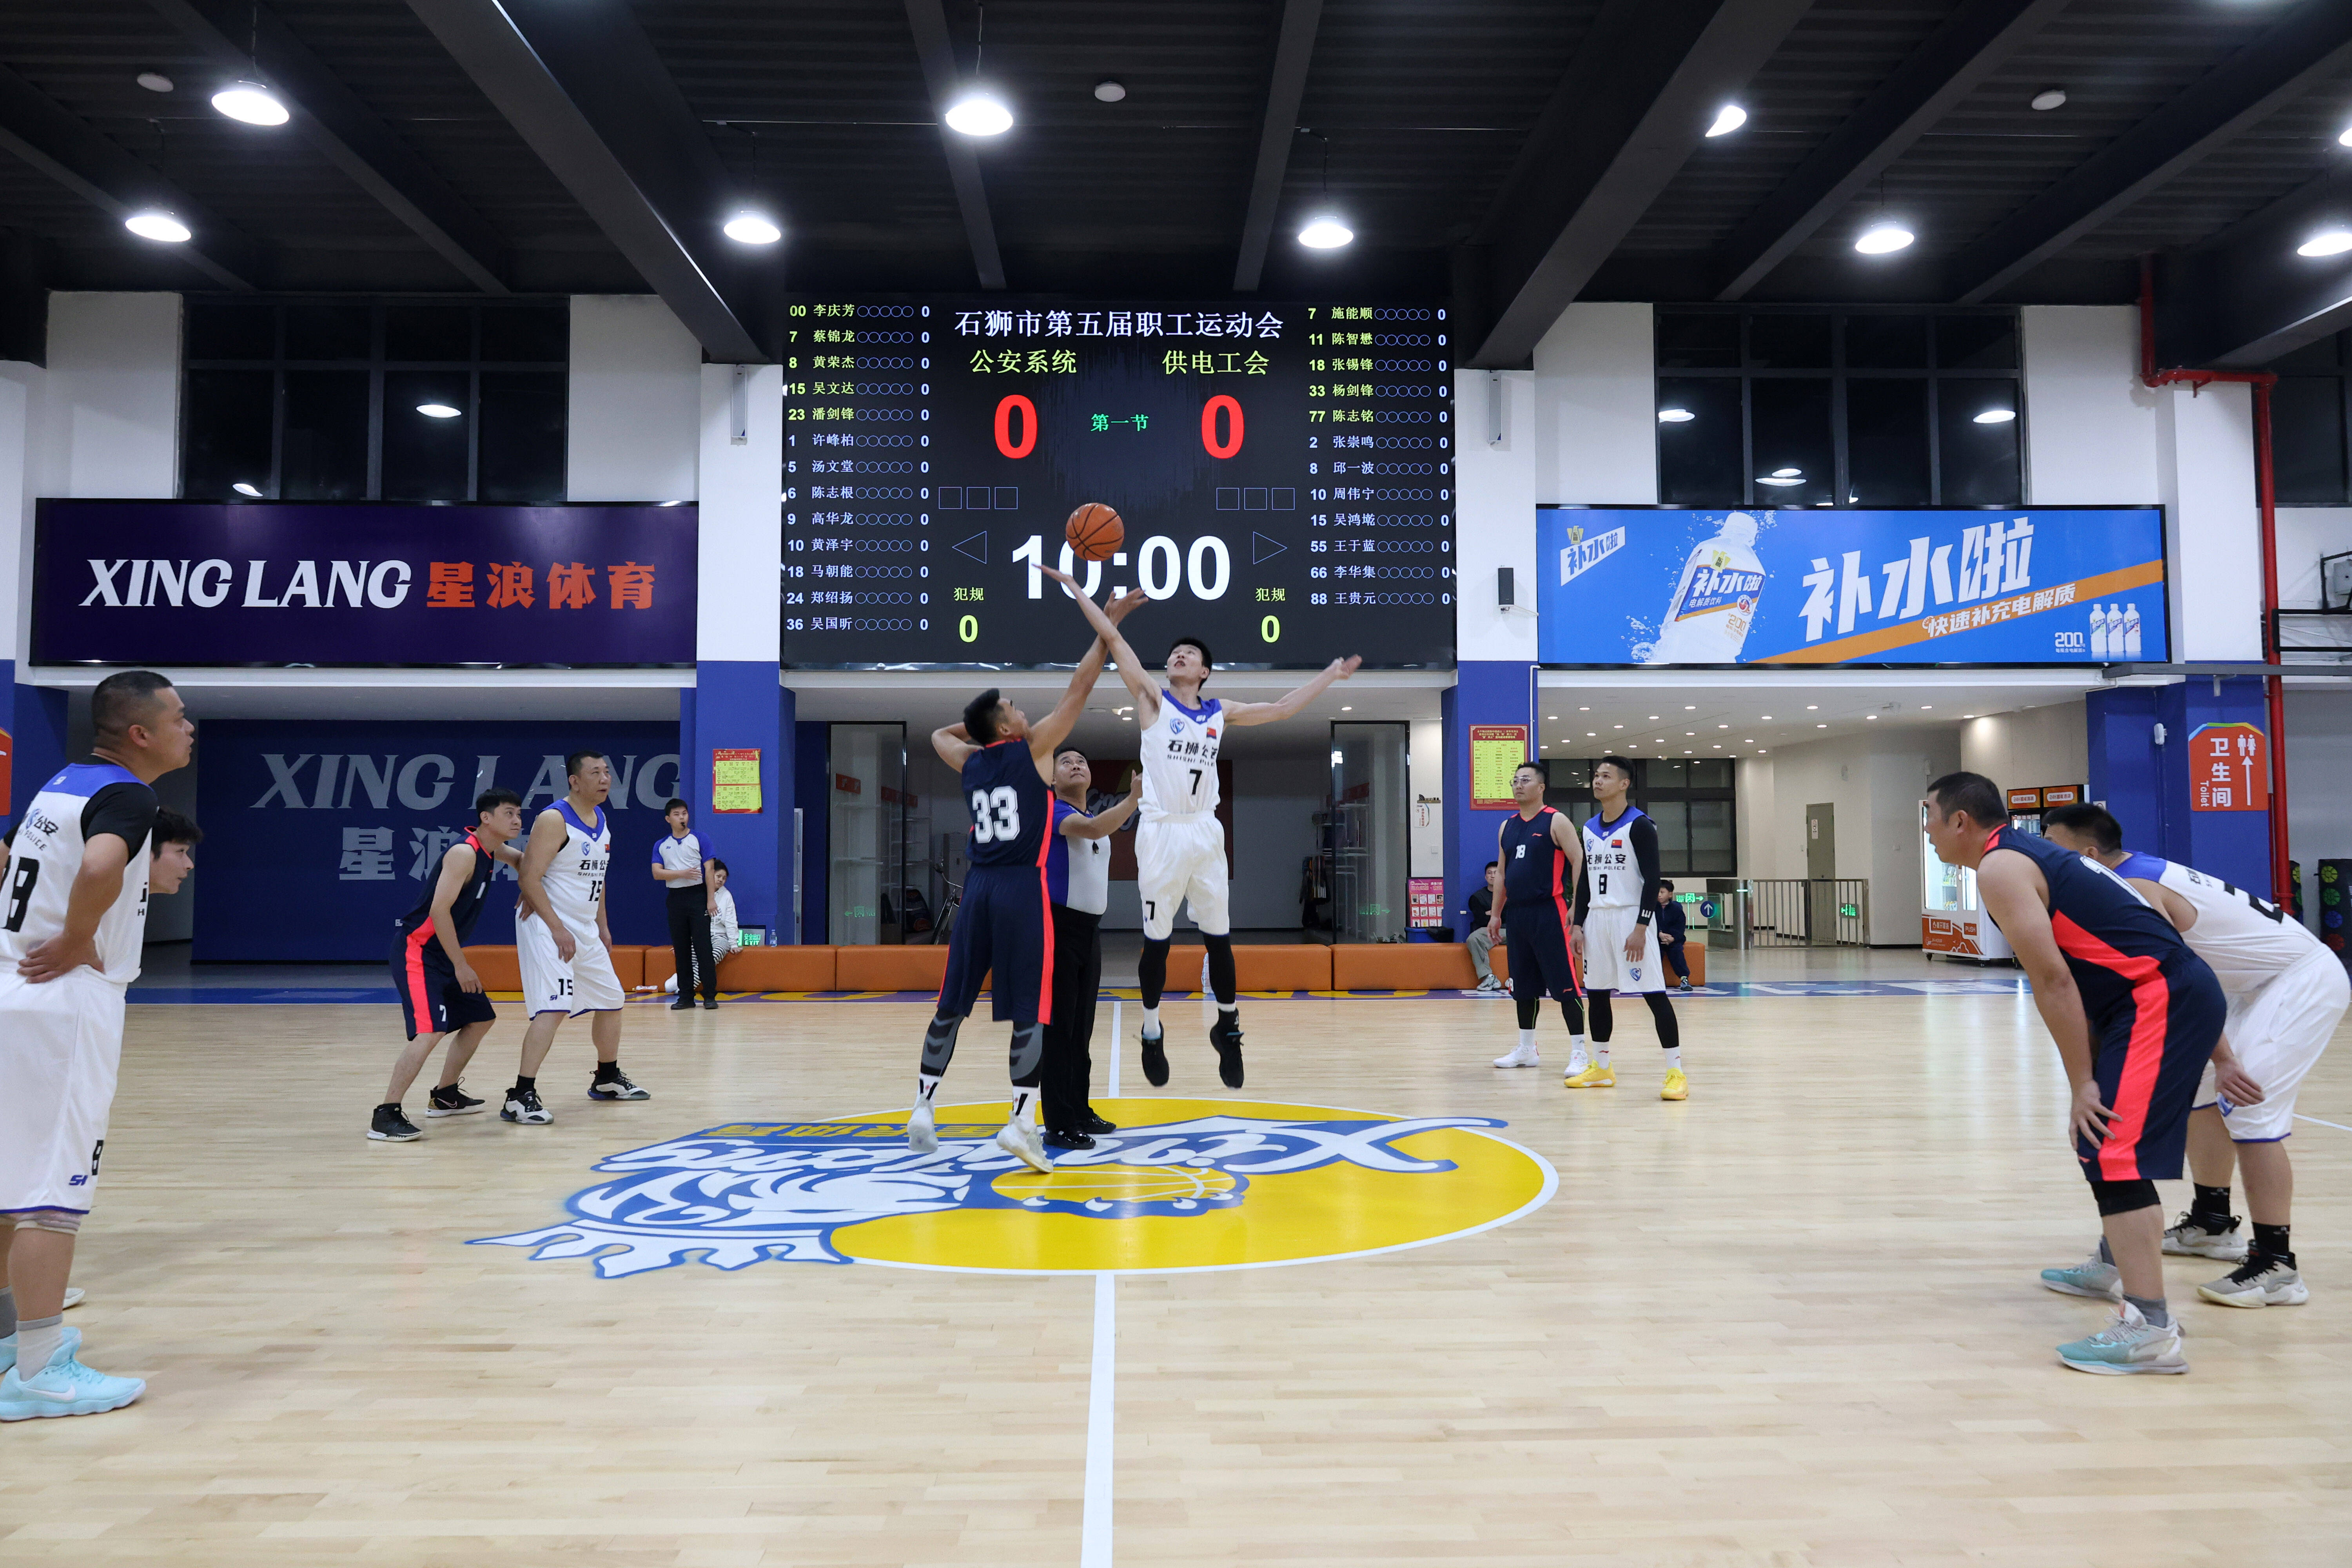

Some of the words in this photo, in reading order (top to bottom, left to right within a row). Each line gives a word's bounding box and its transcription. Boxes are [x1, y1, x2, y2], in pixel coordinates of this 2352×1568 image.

[790, 306, 806, 316] 00
[814, 304, 854, 316] 李庆芳
[922, 306, 929, 317] 0
[1308, 308, 1316, 319] 7
[1332, 307, 1372, 319] 施能顺
[1438, 309, 1445, 320] 0
[955, 310, 1283, 338] 石狮市第五届职工运动会
[790, 331, 797, 342] 7
[813, 330, 855, 342] 蔡锦龙
[922, 332, 929, 343] 0
[1309, 334, 1322, 345] 11
[1438, 335, 1446, 345] 0
[789, 357, 797, 368] 8
[813, 356, 854, 368] 黄荣杰
[922, 358, 929, 369] 0
[970, 350, 1076, 373] 公安系统
[1162, 350, 1269, 374] 供电工会
[1310, 359, 1325, 370] 18
[1332, 358, 1373, 371] 张锡锋
[1439, 360, 1446, 371] 0
[789, 383, 805, 394] 15
[813, 382, 854, 394] 吴文达
[921, 384, 929, 395] 0
[1309, 385, 1325, 396] 33
[1332, 384, 1374, 396] 杨剑锋
[1439, 386, 1447, 397] 0
[789, 409, 805, 420] 23
[812, 407, 854, 420] 潘剑锋
[921, 409, 929, 421] 0
[1309, 411, 1325, 422] 77
[1333, 410, 1374, 422] 陈志铭
[1439, 412, 1447, 423] 0
[995, 395, 1037, 459] 0
[1091, 414, 1149, 431] 第一节
[1201, 395, 1244, 459] 0
[789, 435, 795, 446] 1
[812, 434, 853, 446] 许峰柏
[921, 436, 929, 446] 0
[1309, 437, 1318, 448] 2
[1333, 436, 1374, 448] 张崇鸣
[1440, 437, 1448, 448] 0
[788, 461, 796, 472] 5
[812, 460, 853, 472] 汤文堂
[921, 461, 929, 473] 0
[1310, 463, 1318, 474] 8
[1334, 461, 1374, 474] 邱一波
[1440, 463, 1448, 474] 0
[788, 488, 796, 499] 6
[812, 486, 853, 499] 陈志根
[921, 488, 929, 499] 0
[1310, 489, 1326, 500] 10
[1334, 487, 1374, 500] 周伟宁
[1441, 489, 1448, 500] 0
[788, 514, 795, 524] 9
[812, 512, 853, 524] 高华龙
[920, 514, 929, 525] 0
[1311, 515, 1327, 526] 15
[1441, 515, 1449, 526] 0
[788, 540, 804, 551] 10
[811, 538, 853, 551] 黄泽宇
[920, 540, 928, 551] 0
[1310, 541, 1327, 552] 55
[1334, 539, 1375, 552] 王于蓝
[1441, 541, 1449, 552] 0
[1567, 532, 1618, 575] 补水啦
[788, 566, 804, 577] 18
[811, 564, 853, 577] 马朝能
[920, 566, 928, 577] 0
[1012, 535, 1230, 600] 10:00
[1311, 567, 1327, 578] 66
[1334, 565, 1376, 578] 李华集
[1442, 567, 1450, 578] 0
[79, 559, 232, 608] XING
[241, 560, 412, 608] LANG
[427, 561, 655, 609] 星浪体育
[1692, 569, 1763, 597] 补水啦
[1798, 517, 2034, 642] 补水啦
[788, 592, 804, 604] 24
[811, 591, 853, 604] 郑绍扬
[920, 593, 928, 604] 0
[954, 587, 984, 601] 犯规
[1256, 588, 1285, 601] 犯规
[1311, 593, 1327, 604] 88
[1334, 592, 1376, 604] 王贵元
[1442, 593, 1450, 604] 0
[1926, 583, 2076, 638] 快速补充电解质
[788, 619, 803, 630] 36
[811, 617, 853, 630] 吴国昕
[920, 619, 928, 630] 0
[960, 615, 978, 642] 0
[1262, 615, 1279, 642] 0
[2055, 632, 2083, 647] 200
[2210, 738, 2232, 808] 卫生间
[249, 754, 455, 810] XING
[1189, 768, 1202, 795] 7
[2200, 780, 2209, 808] Toilet
[972, 786, 1020, 844] 33
[1515, 845, 1525, 859] 18
[579, 860, 609, 871] 石狮公
[588, 880, 603, 902] 15
[1599, 874, 1608, 895] 8
[1145, 901, 1155, 920] 7
[558, 978, 573, 996] 15
[439, 1004, 446, 1022] 7
